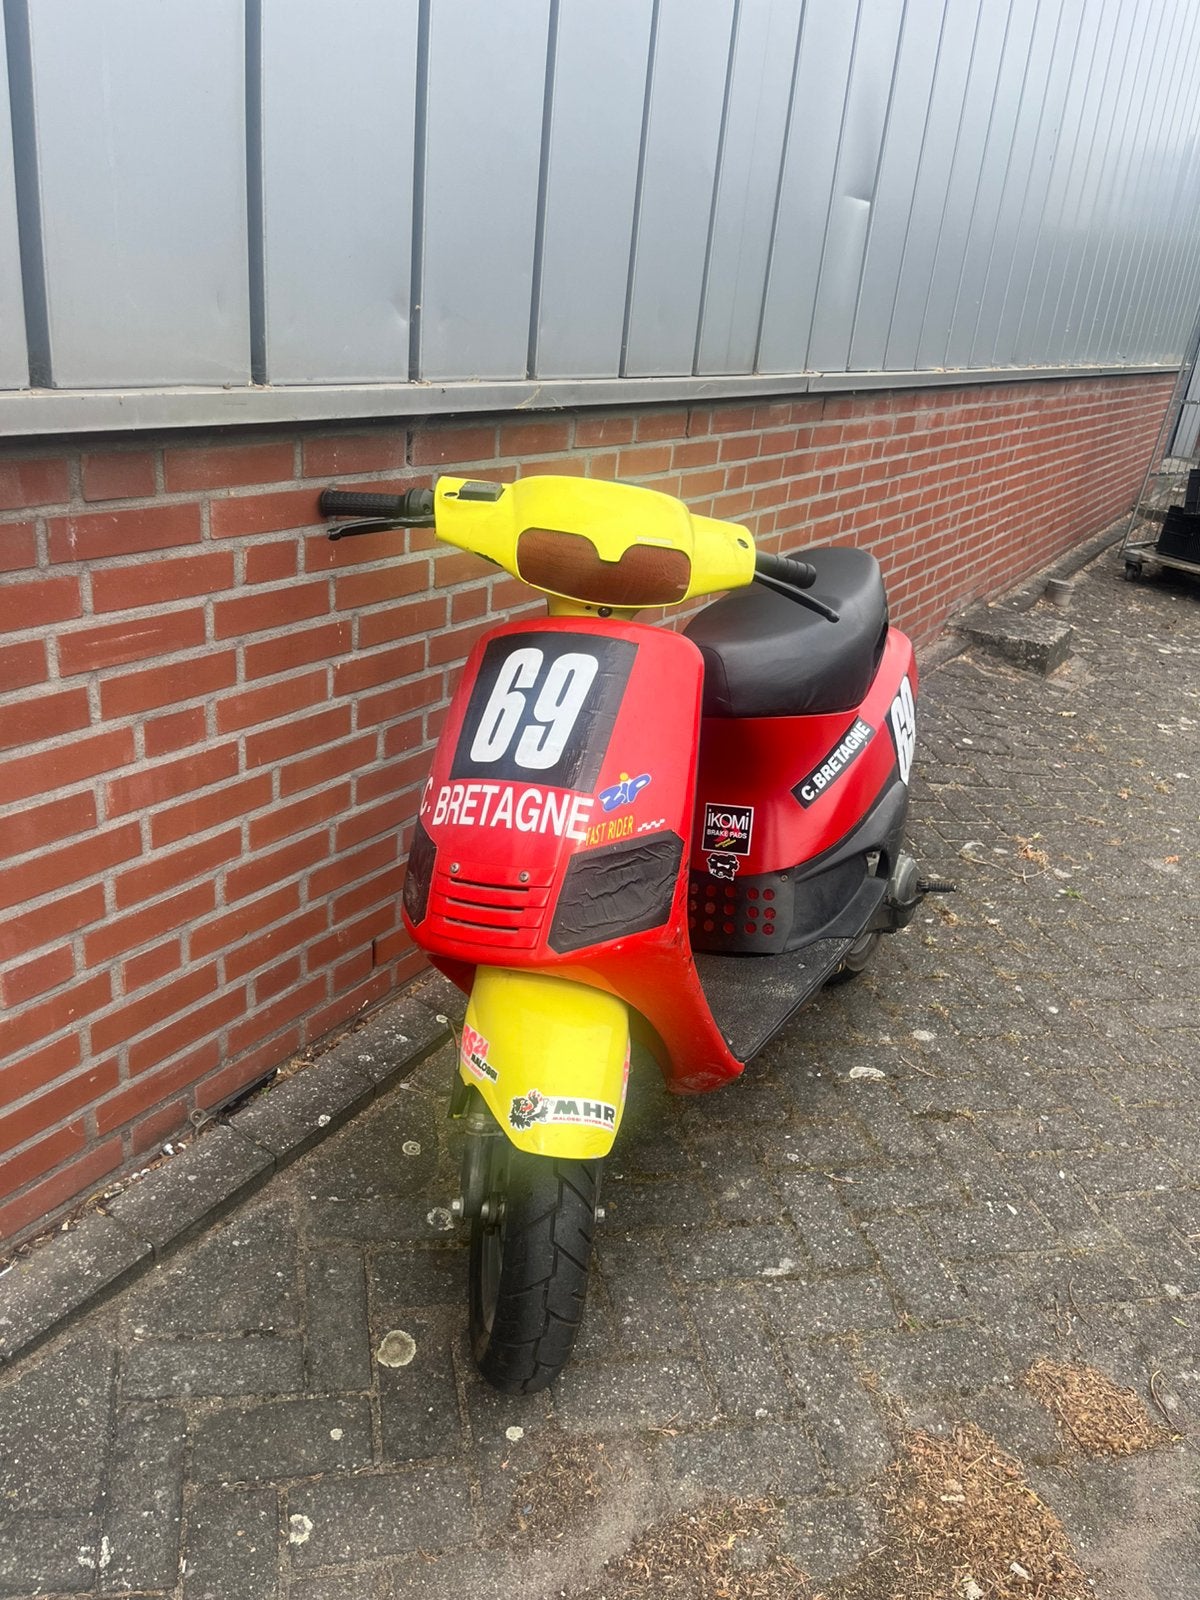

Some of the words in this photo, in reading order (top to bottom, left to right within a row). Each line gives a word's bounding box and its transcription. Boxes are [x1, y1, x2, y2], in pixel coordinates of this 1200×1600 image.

[470, 648, 599, 769] 69
[432, 784, 594, 841] BRETAGNE
[585, 823, 606, 846] FAST
[607, 815, 634, 840] RIDER
[706, 828, 729, 838] BRAKE
[729, 831, 748, 839] PADS
[553, 1099, 615, 1124] MHR
